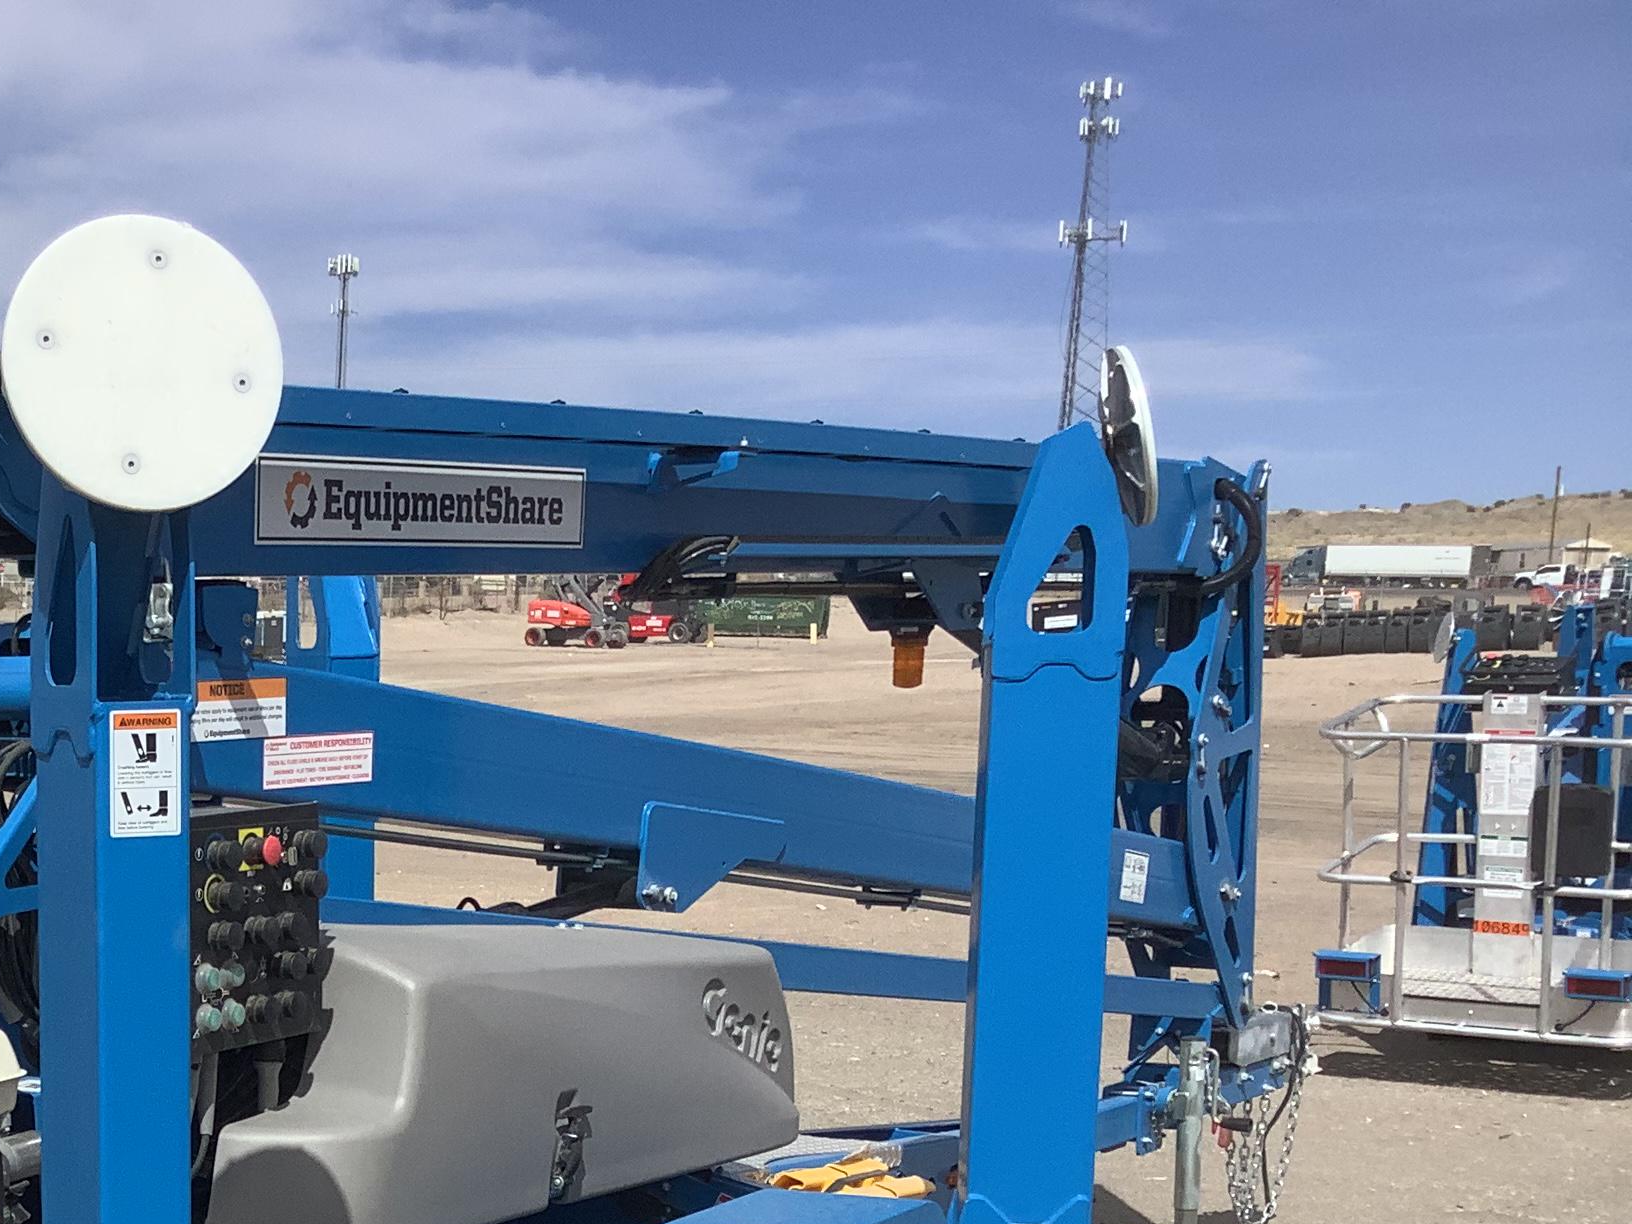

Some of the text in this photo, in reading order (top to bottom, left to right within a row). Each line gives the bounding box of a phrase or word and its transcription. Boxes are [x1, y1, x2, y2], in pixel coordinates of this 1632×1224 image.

[323, 478, 563, 531] EquipmentShare
[209, 683, 245, 697] NOTICE
[126, 717, 172, 727] WARNING
[290, 740, 322, 750] CUSTOMER
[324, 737, 371, 748] RESPONSIBILITY
[701, 977, 782, 1073] Genie
